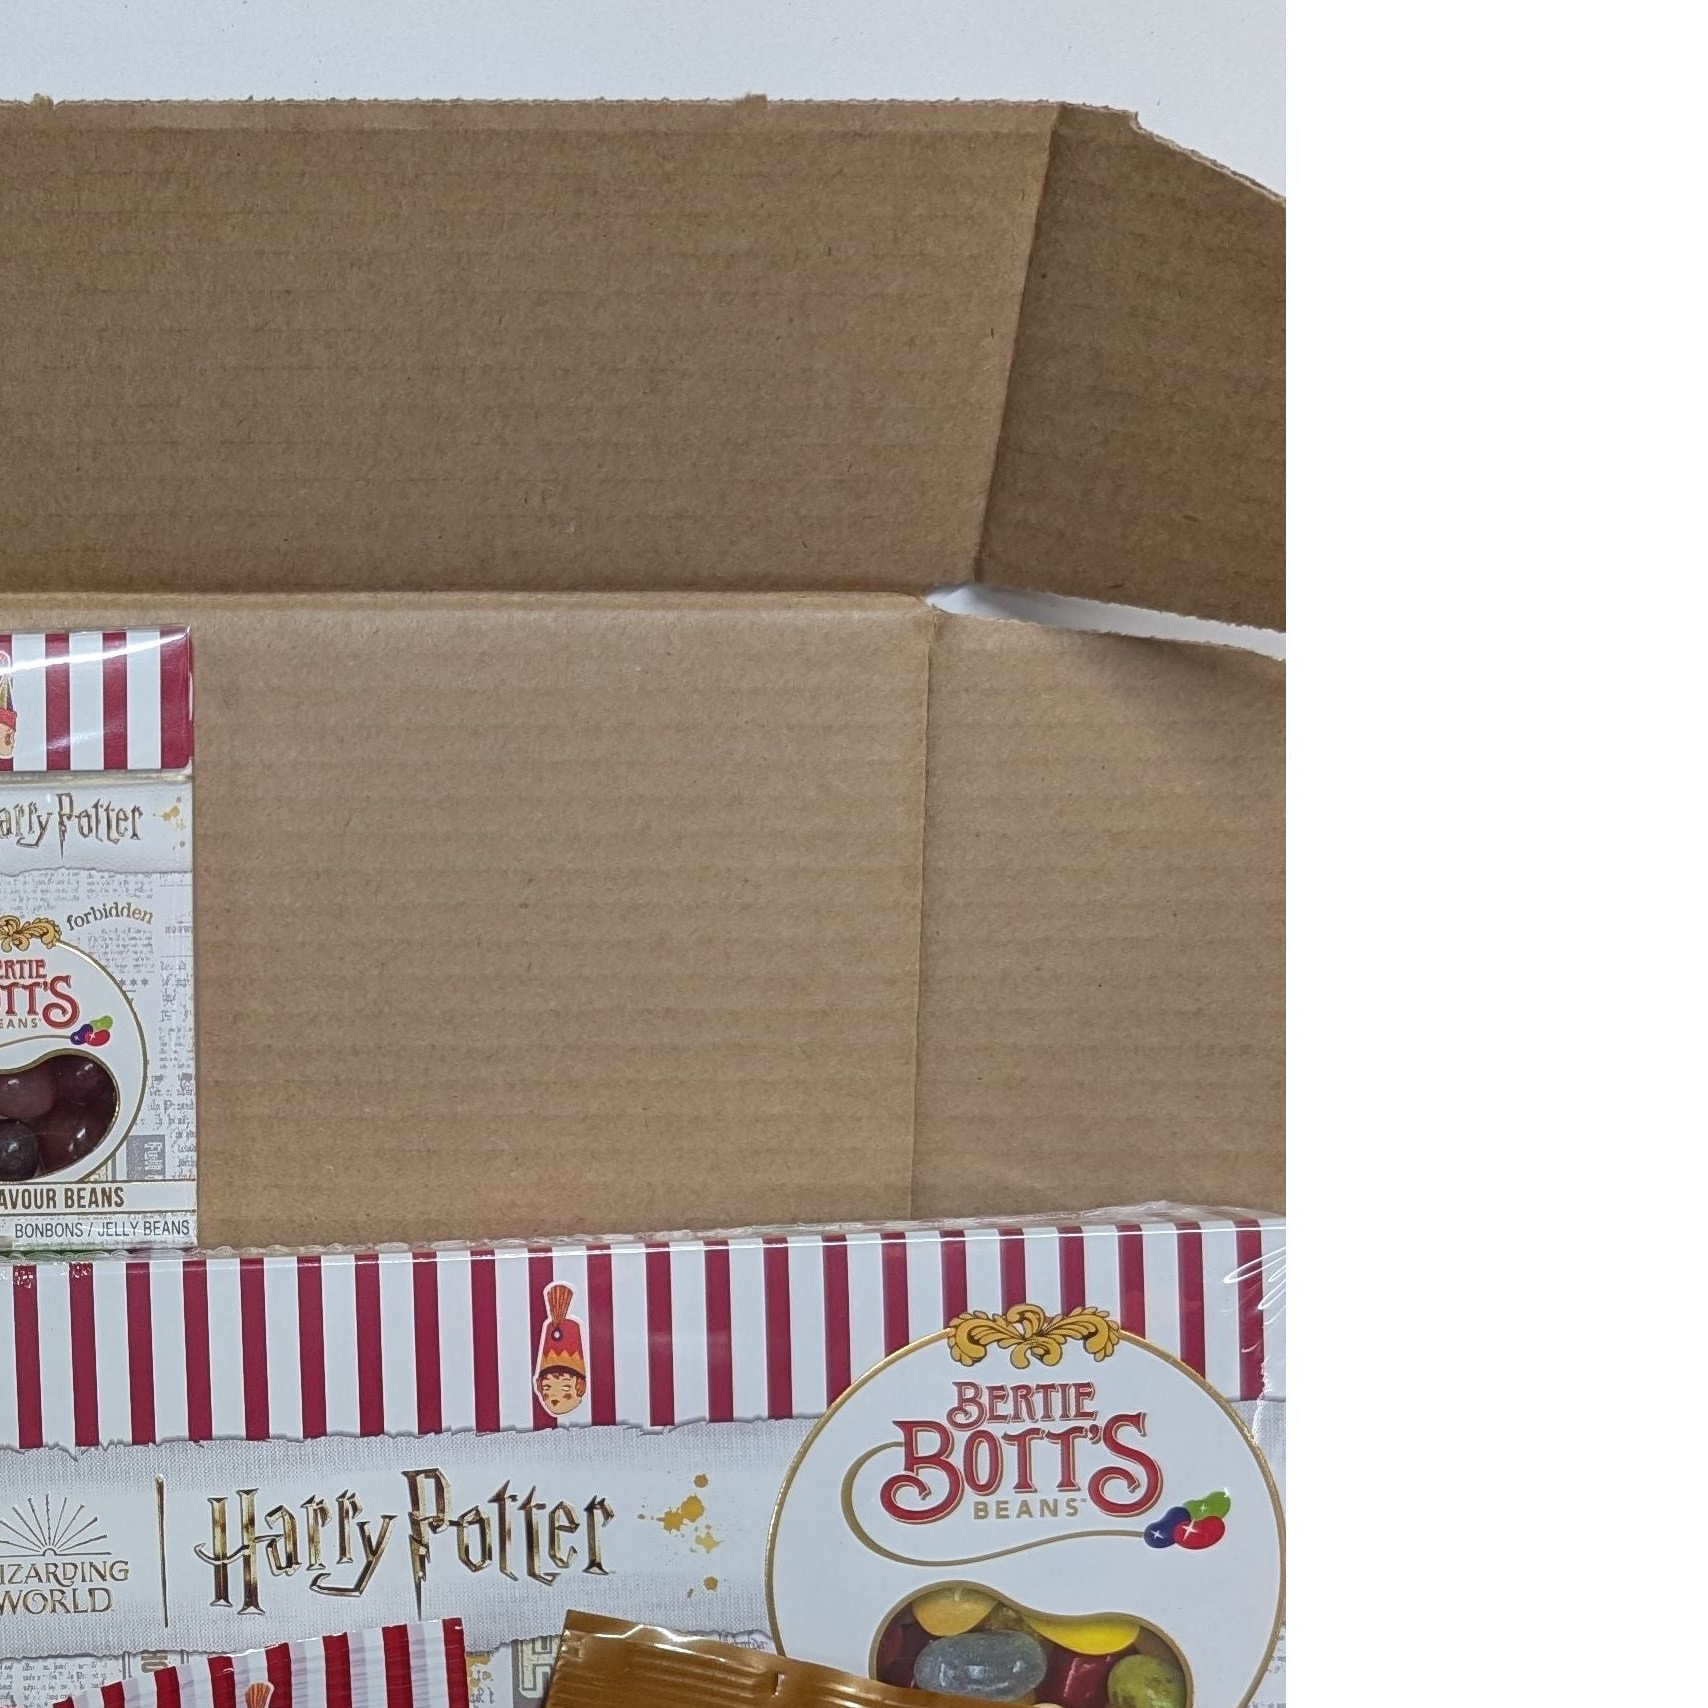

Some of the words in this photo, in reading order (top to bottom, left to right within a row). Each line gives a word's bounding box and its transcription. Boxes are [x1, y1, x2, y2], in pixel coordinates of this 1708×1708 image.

[56, 793, 143, 860] Potter
[66, 902, 153, 931] forbidden
[64, 1185, 125, 1210] BEANS
[14, 1222, 84, 1240] BONBONS
[97, 1221, 140, 1239] JELLY
[143, 1219, 191, 1236] BEANS
[946, 1381, 1098, 1430] BERTIE
[879, 1411, 1163, 1525] BOTT'S
[973, 1498, 1079, 1520] BEANS
[194, 1487, 399, 1616] Harry
[401, 1467, 616, 1621] Potter
